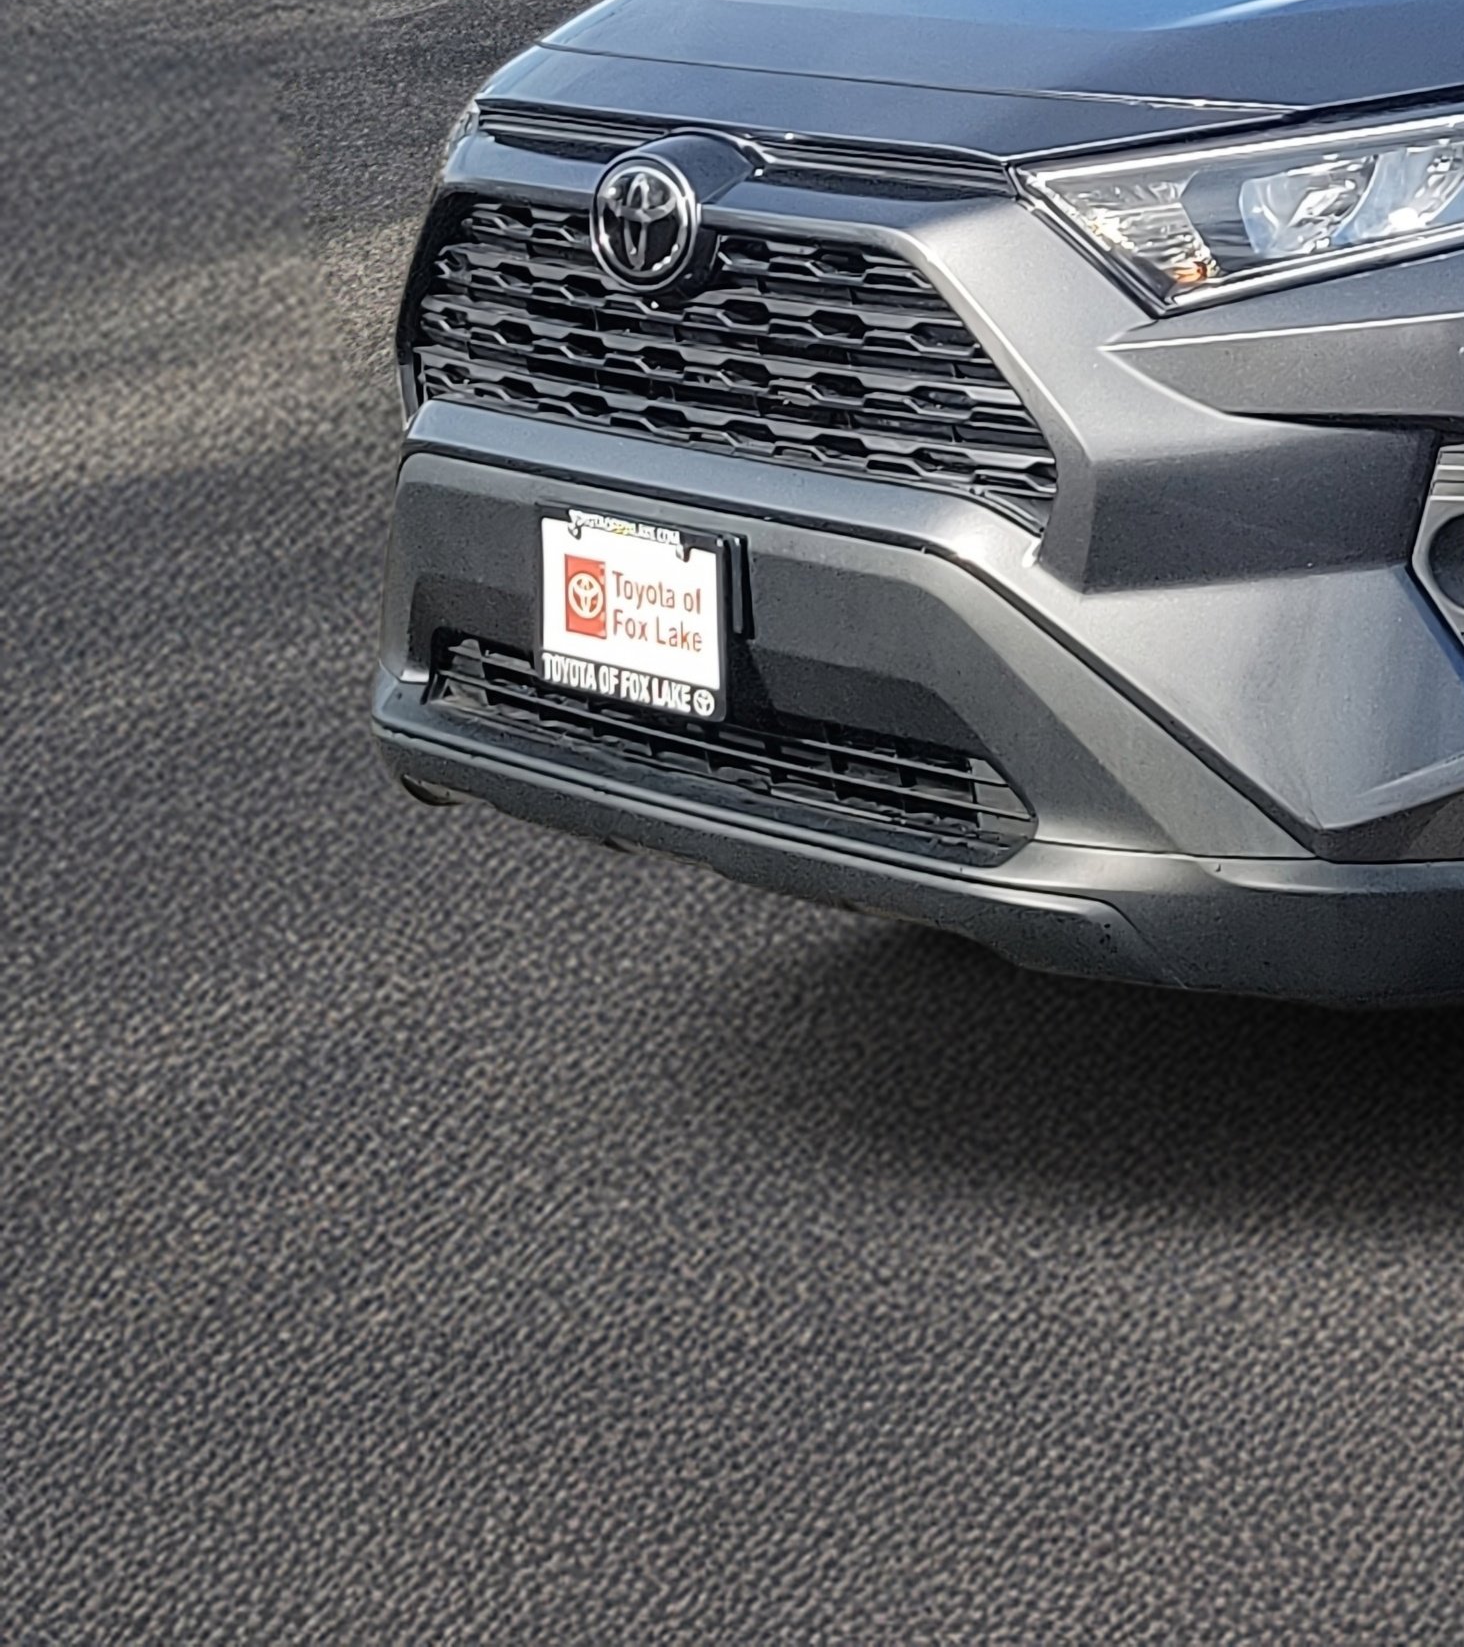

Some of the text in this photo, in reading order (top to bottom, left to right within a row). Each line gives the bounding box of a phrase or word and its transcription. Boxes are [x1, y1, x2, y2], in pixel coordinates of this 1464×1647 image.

[612, 570, 675, 610] Toyota
[613, 608, 702, 653] Fox Lake
[542, 652, 691, 713] TOYOTA OF FOX LAKE
